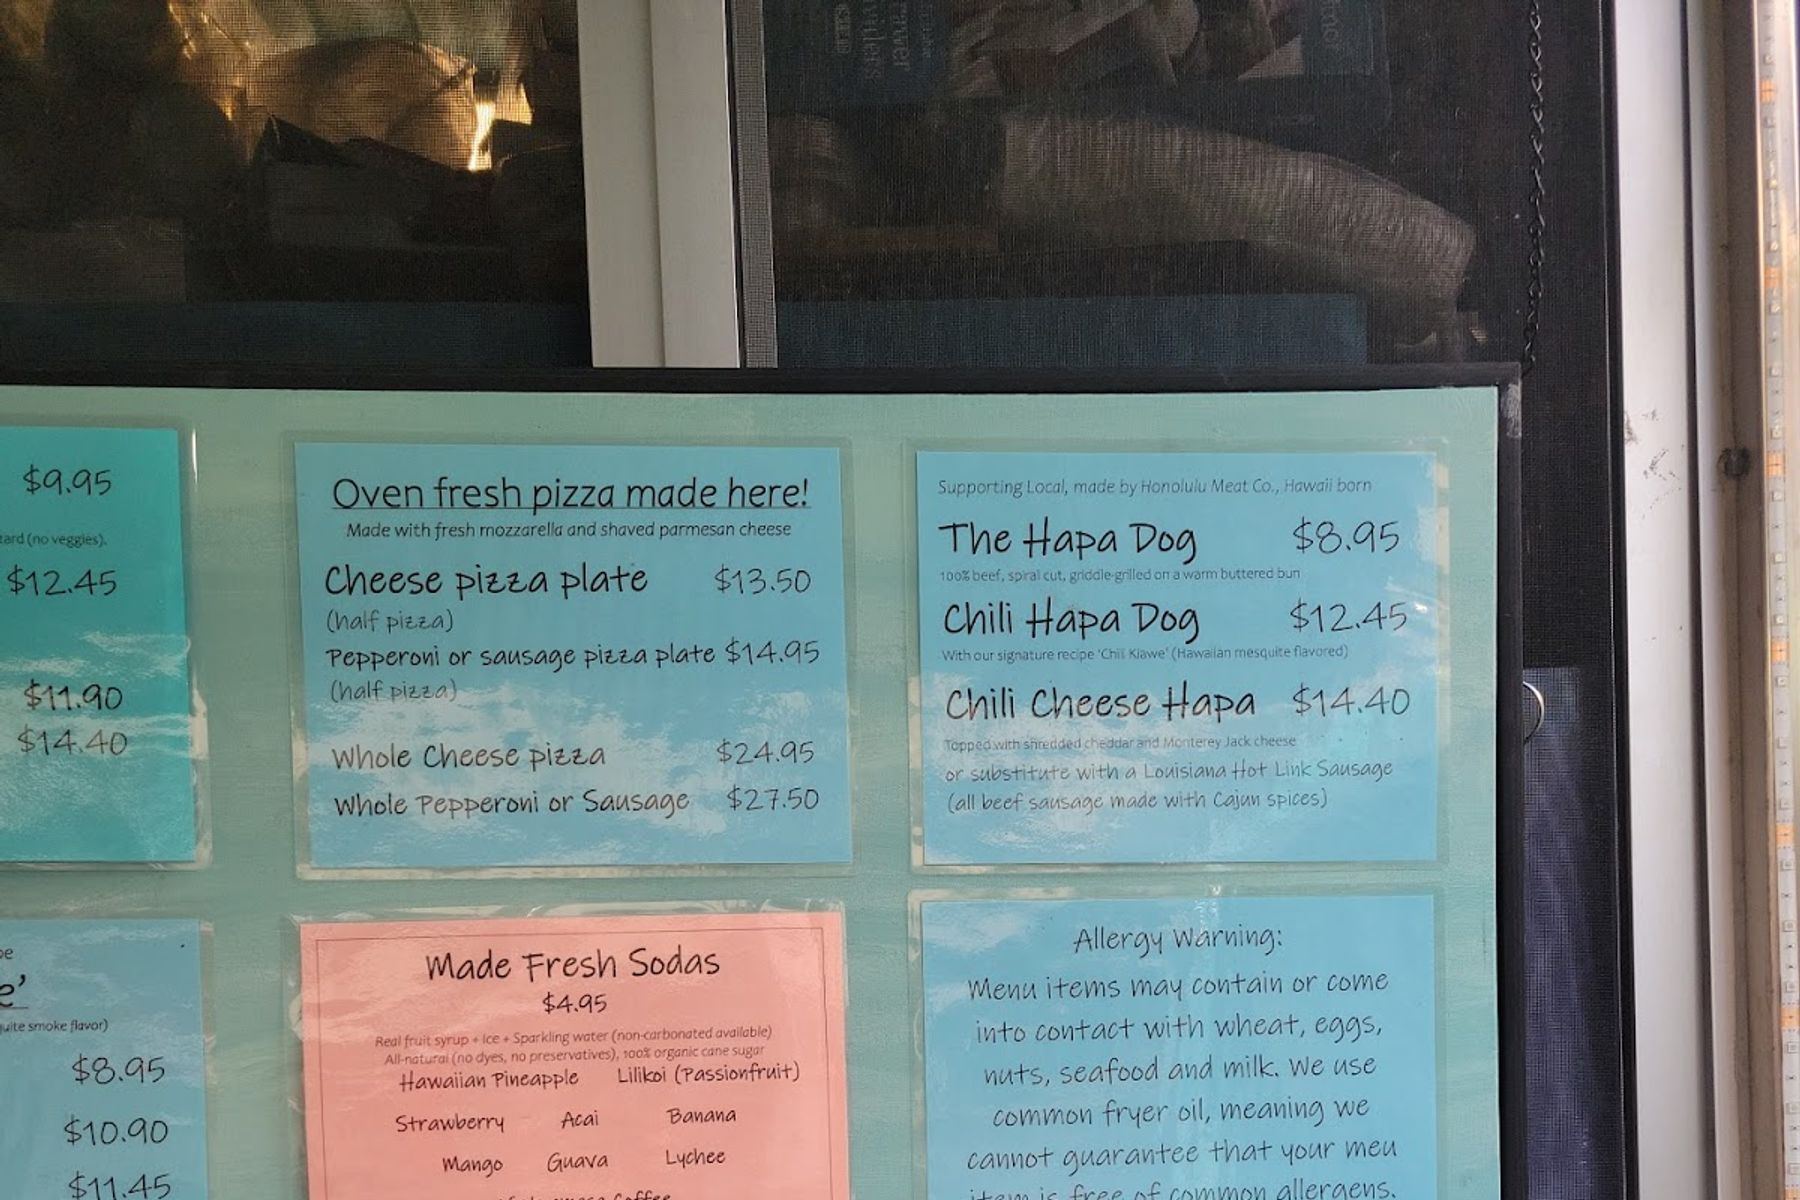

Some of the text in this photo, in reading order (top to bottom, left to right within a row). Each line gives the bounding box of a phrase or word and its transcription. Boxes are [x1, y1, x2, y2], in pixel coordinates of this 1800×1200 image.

[23, 464, 111, 495] $9.95
[938, 477, 1372, 499] Supporting Local, made by Honolulu Meat Co., Hawaii born
[333, 476, 808, 516] Oven fresh pizza made here!
[27, 533, 107, 549] (no veggies).
[347, 521, 791, 541] Made with fresh mozzarella and shaved parmesan cheese
[938, 516, 1399, 565] The Hapa Dog $8.95
[7, 564, 117, 596] $12.45
[325, 562, 811, 601] Cheese pizza plate $13.50
[327, 609, 453, 634] (half pizza)
[944, 596, 1407, 644] Chili Hapa Dog $12.45
[325, 637, 819, 673] Pepperoni or sausage pizza plate $14.95
[24, 678, 123, 714] $11.90
[331, 678, 457, 703] (half pizza)
[947, 680, 1410, 723] Chili Cheese Hapa $14.40
[17, 724, 128, 756] $14.40
[332, 739, 814, 772] Whole Cheese pizza $24.95
[334, 784, 819, 819] Whole Pepperoni or Sausage $27.50
[1073, 926, 1282, 959] Allergy Warning:
[426, 944, 720, 982] Made Fresh Sodas
[968, 971, 1388, 1001] Menu items may contain or come
[542, 992, 607, 1014] $4.95
[28, 1018, 108, 1033] smoke flavor)
[977, 1013, 1381, 1044] into contact with wheat, eggs,
[72, 1054, 165, 1085] $8.95
[399, 1061, 799, 1092] Hawaiian Pineapple Lilikoi (Passionfruit)
[64, 1115, 168, 1146] $10.90
[395, 1108, 736, 1133] Strawberry Acai Banana
[442, 1148, 725, 1177] Mango Guava Lychee
